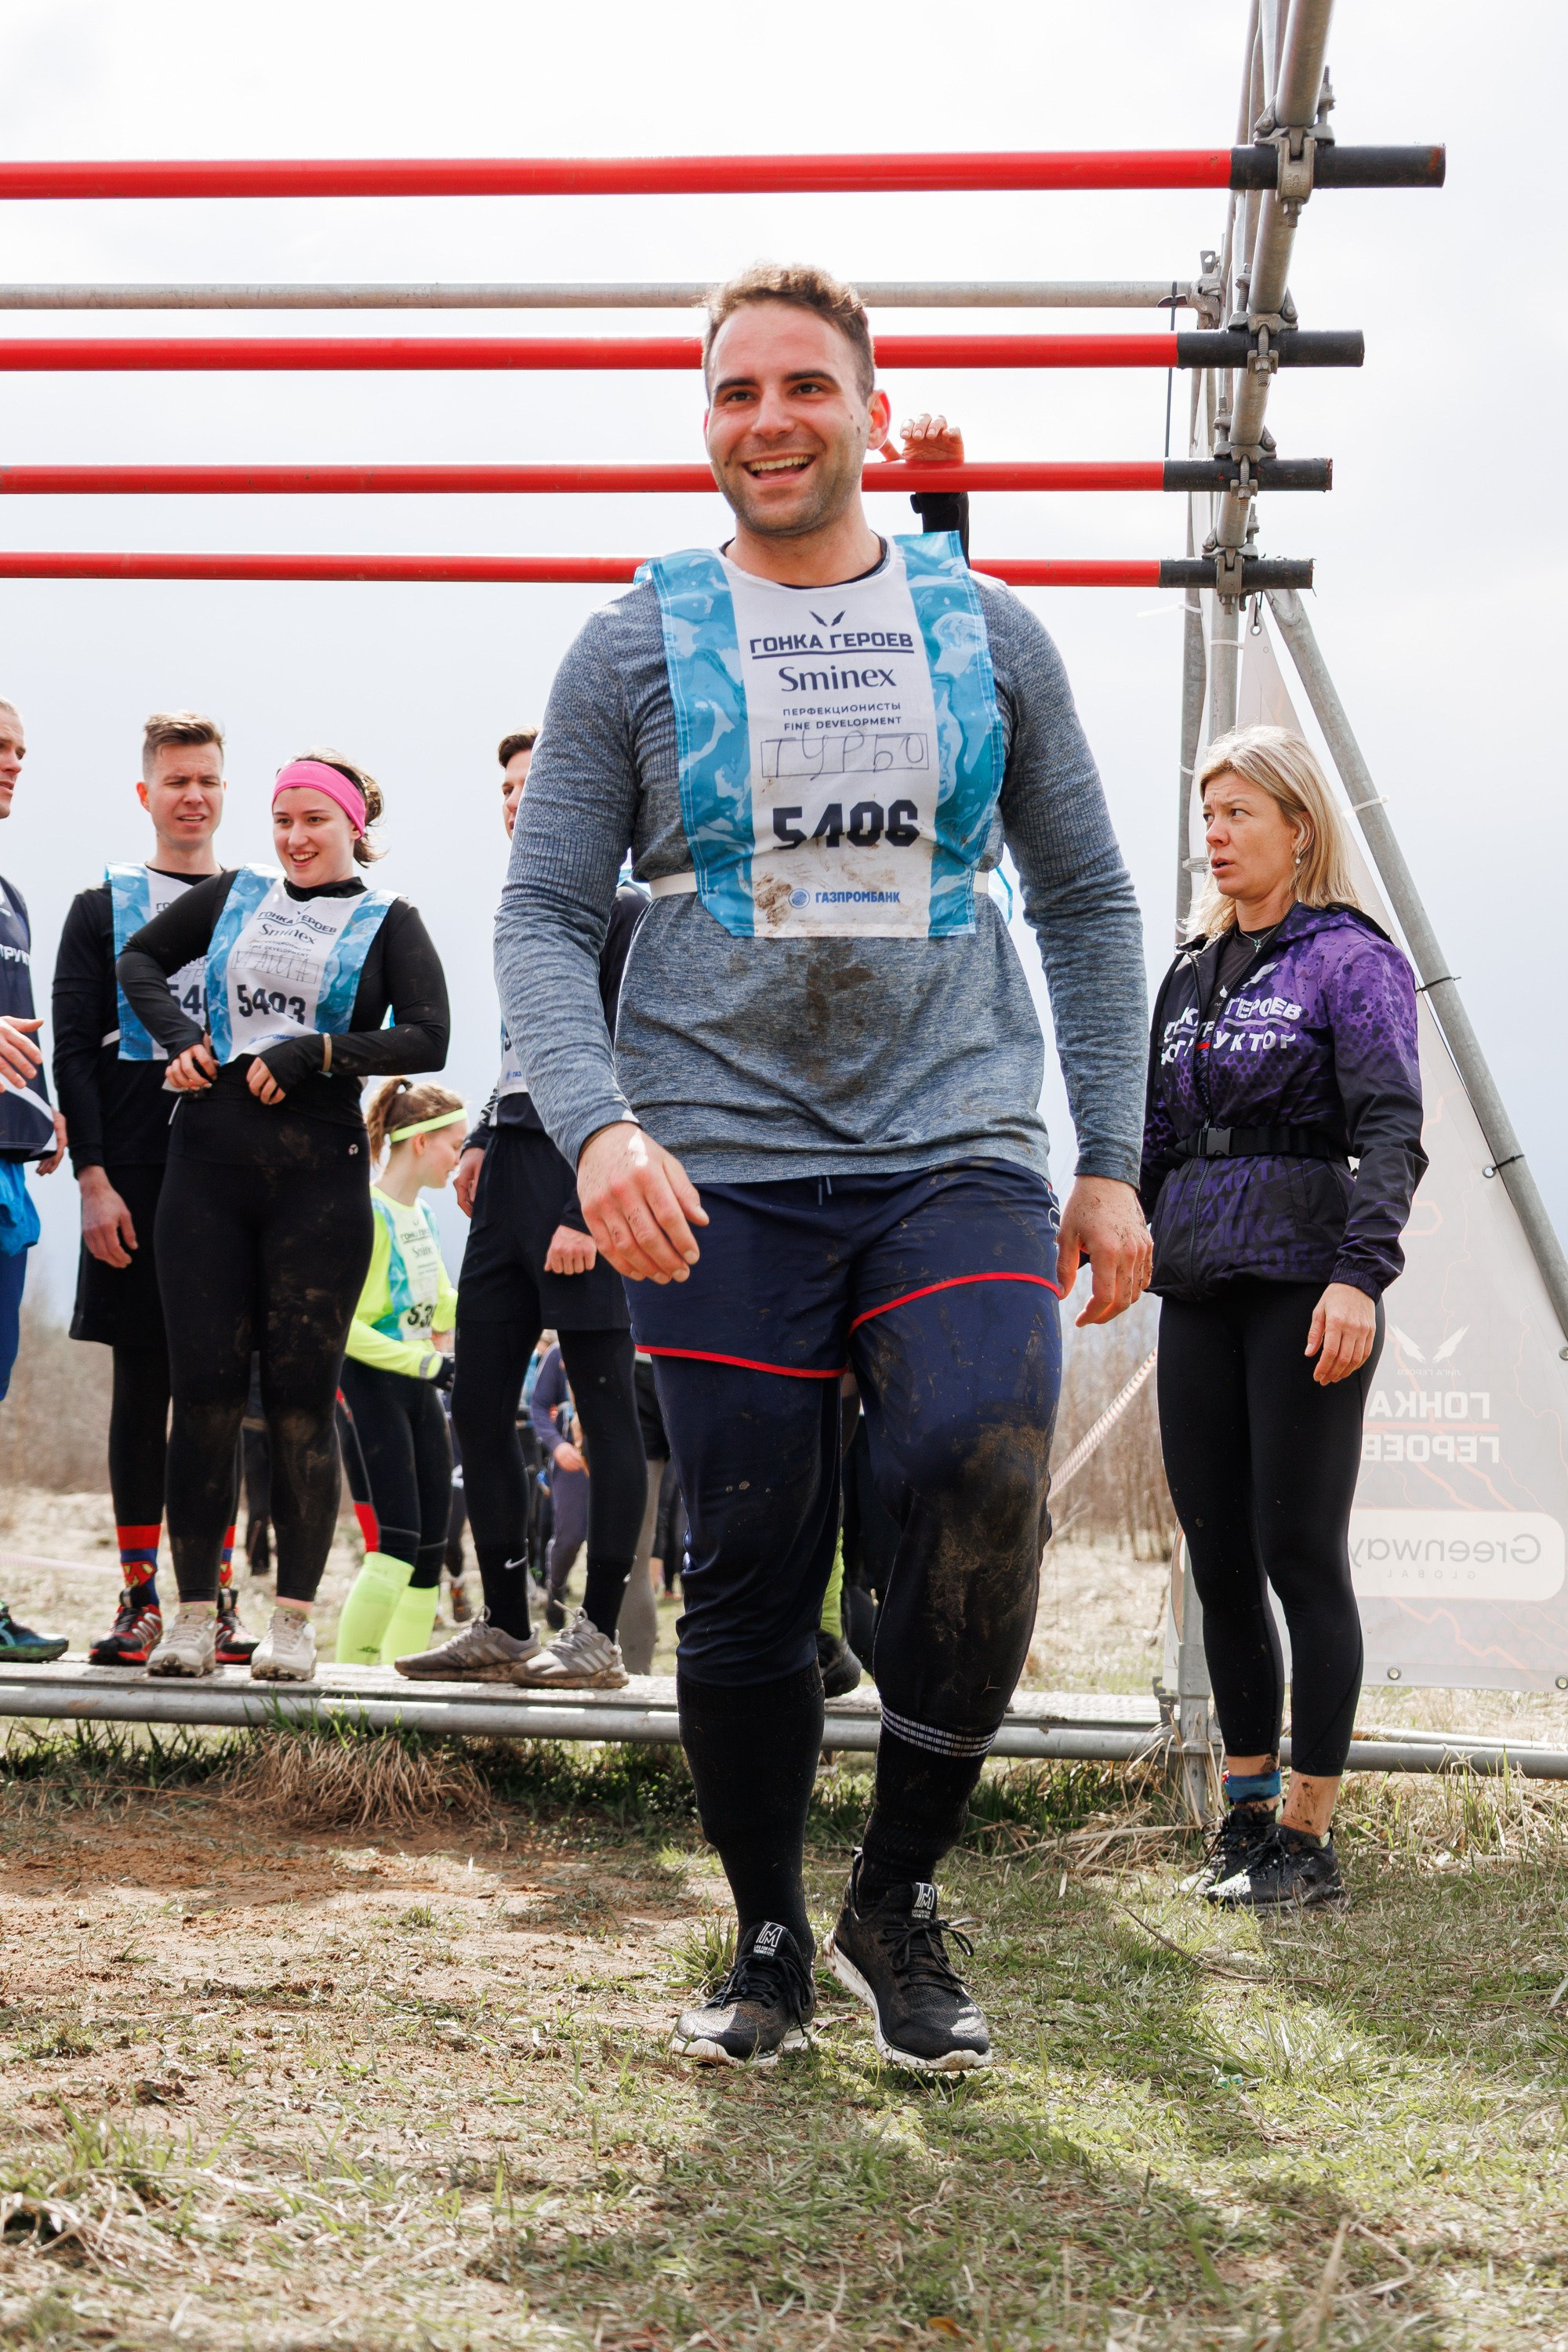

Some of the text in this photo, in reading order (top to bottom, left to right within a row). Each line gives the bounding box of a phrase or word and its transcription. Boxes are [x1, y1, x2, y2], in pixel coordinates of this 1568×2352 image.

[750, 632, 913, 654] ГОНКА ГЕРОЕВ
[779, 665, 897, 692] Sminex
[782, 702, 901, 717] ПЕРФЕКЦИОНИСТЫ
[784, 717, 902, 731] FINE DEVELOPMENT
[772, 799, 920, 850] 5406
[815, 891, 900, 903] ГАЗПРОМБАНК
[258, 911, 293, 925] ГОНКА
[258, 923, 318, 945] Sminex
[1224, 996, 1302, 1020] ГЕРОЕВ
